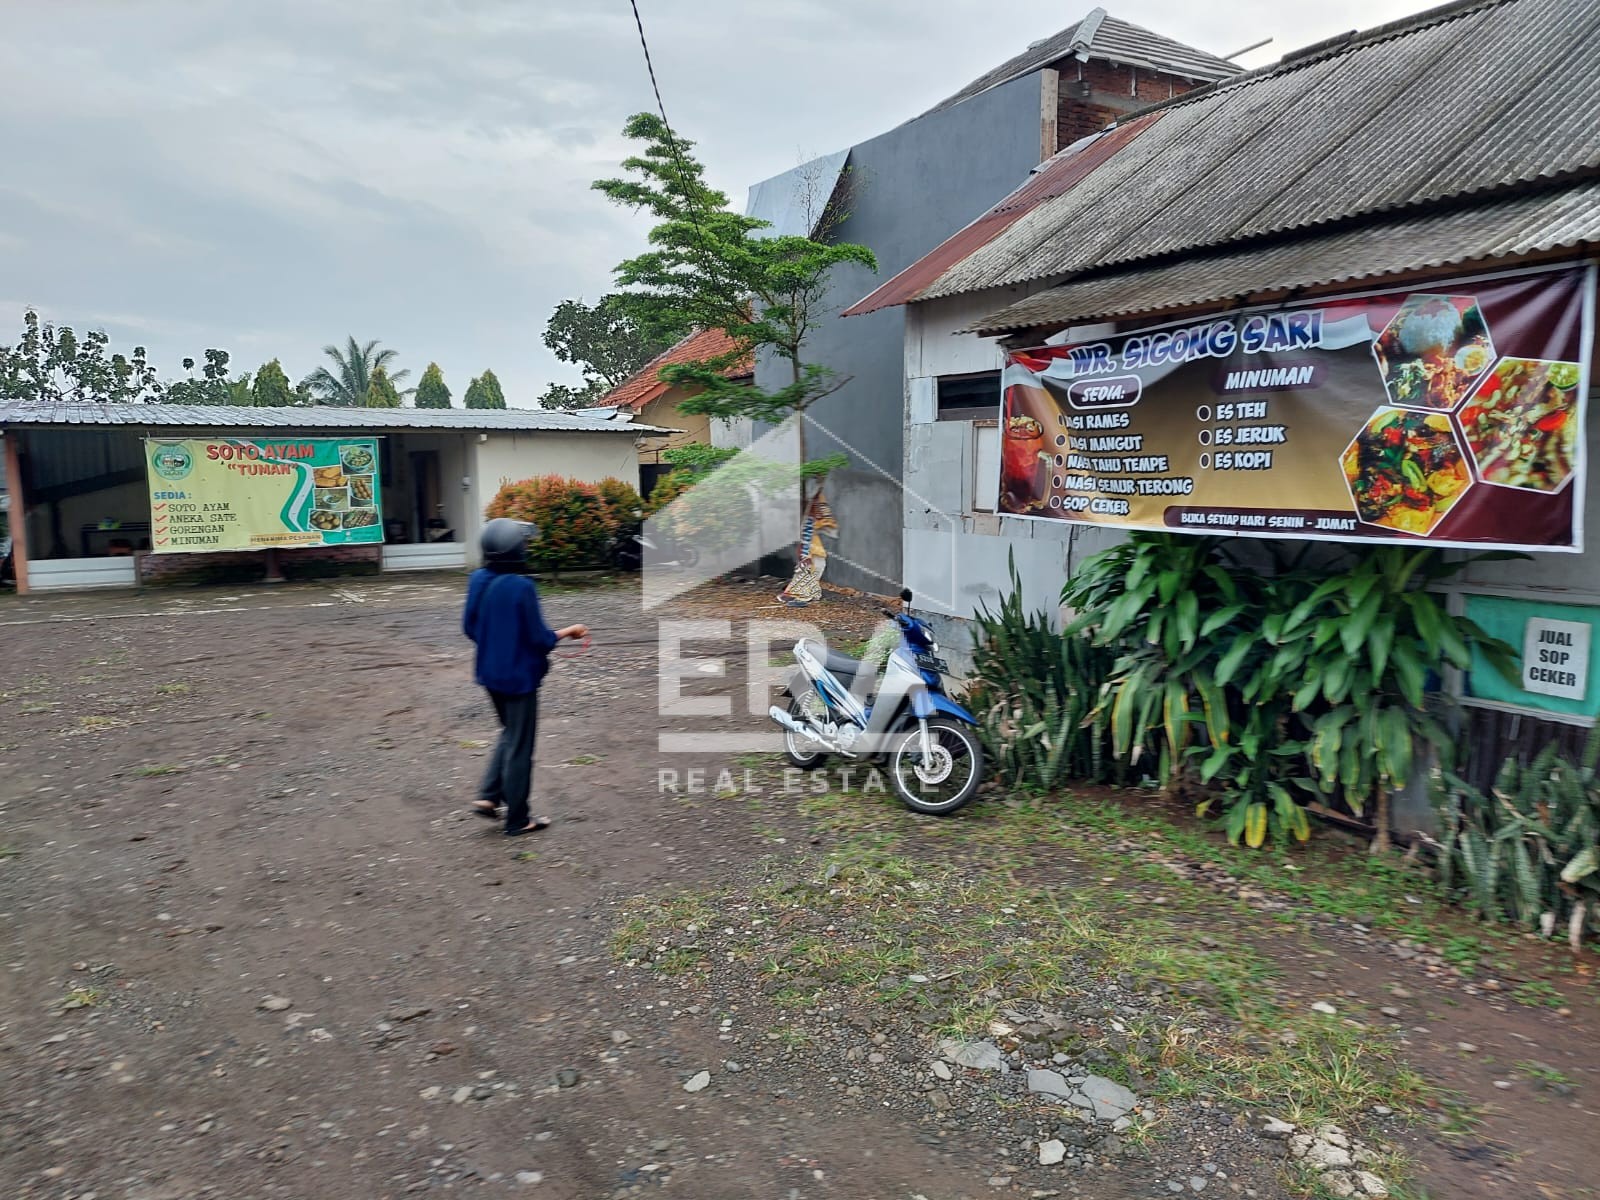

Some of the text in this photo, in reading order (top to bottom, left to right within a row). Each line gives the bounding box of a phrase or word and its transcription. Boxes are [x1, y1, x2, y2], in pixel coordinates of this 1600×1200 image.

[1067, 309, 1325, 376] WR. SIGONG SARI
[1224, 366, 1315, 390] MINUMAN
[1081, 384, 1126, 402] SEDIA:
[1216, 401, 1267, 420] ES TEH
[1086, 412, 1130, 429] RAMES
[1089, 435, 1142, 452] MANGUT
[1214, 426, 1287, 445] ES JERUK
[206, 443, 315, 461] SOTO AYAM
[1214, 451, 1272, 469] ES KOPI
[1092, 456, 1121, 472] TAHU
[1122, 456, 1168, 472] TEMPE
[1065, 475, 1194, 495] NASI SEMUR TERONG
[168, 502, 230, 513] SOTO AYAM
[1062, 496, 1130, 515] SOP CEKER
[169, 513, 238, 523] ANEKA SATE
[1181, 512, 1205, 524] BUKA
[1206, 513, 1239, 526] SETIAP
[1239, 515, 1266, 527] HARI
[1267, 516, 1304, 528] SENIN
[1314, 517, 1357, 531] JUMAT
[169, 524, 225, 534] GORENGAN
[171, 535, 219, 545] MINUMAN
[1538, 629, 1573, 647] JUAL
[1539, 649, 1570, 666] SOP
[1529, 666, 1577, 687] CEKER
